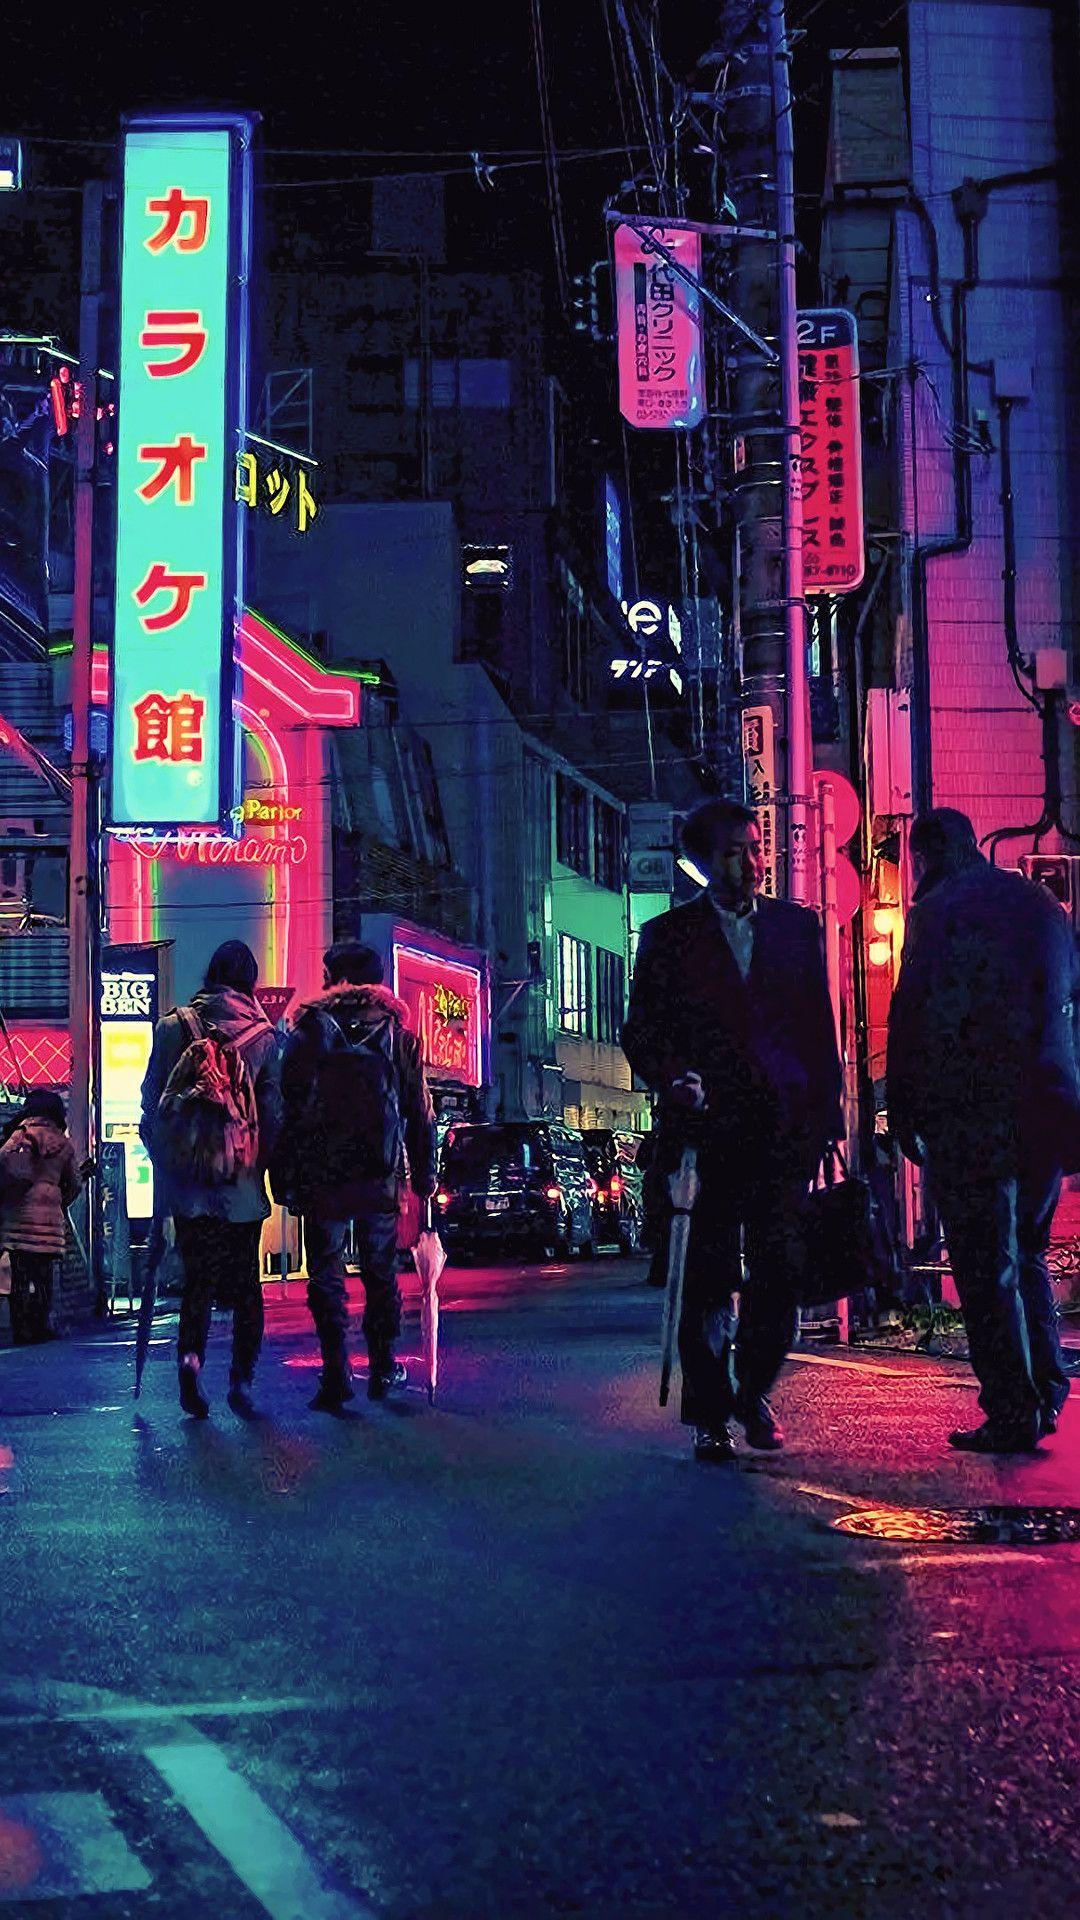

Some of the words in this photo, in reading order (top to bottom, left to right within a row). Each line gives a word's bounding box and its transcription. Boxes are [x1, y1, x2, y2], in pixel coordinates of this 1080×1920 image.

[797, 319, 836, 344] 2F
[131, 187, 209, 765] カラオケ館
[248, 799, 303, 820] Parlor
[101, 981, 151, 999] BIG
[101, 997, 152, 1015] BEN
